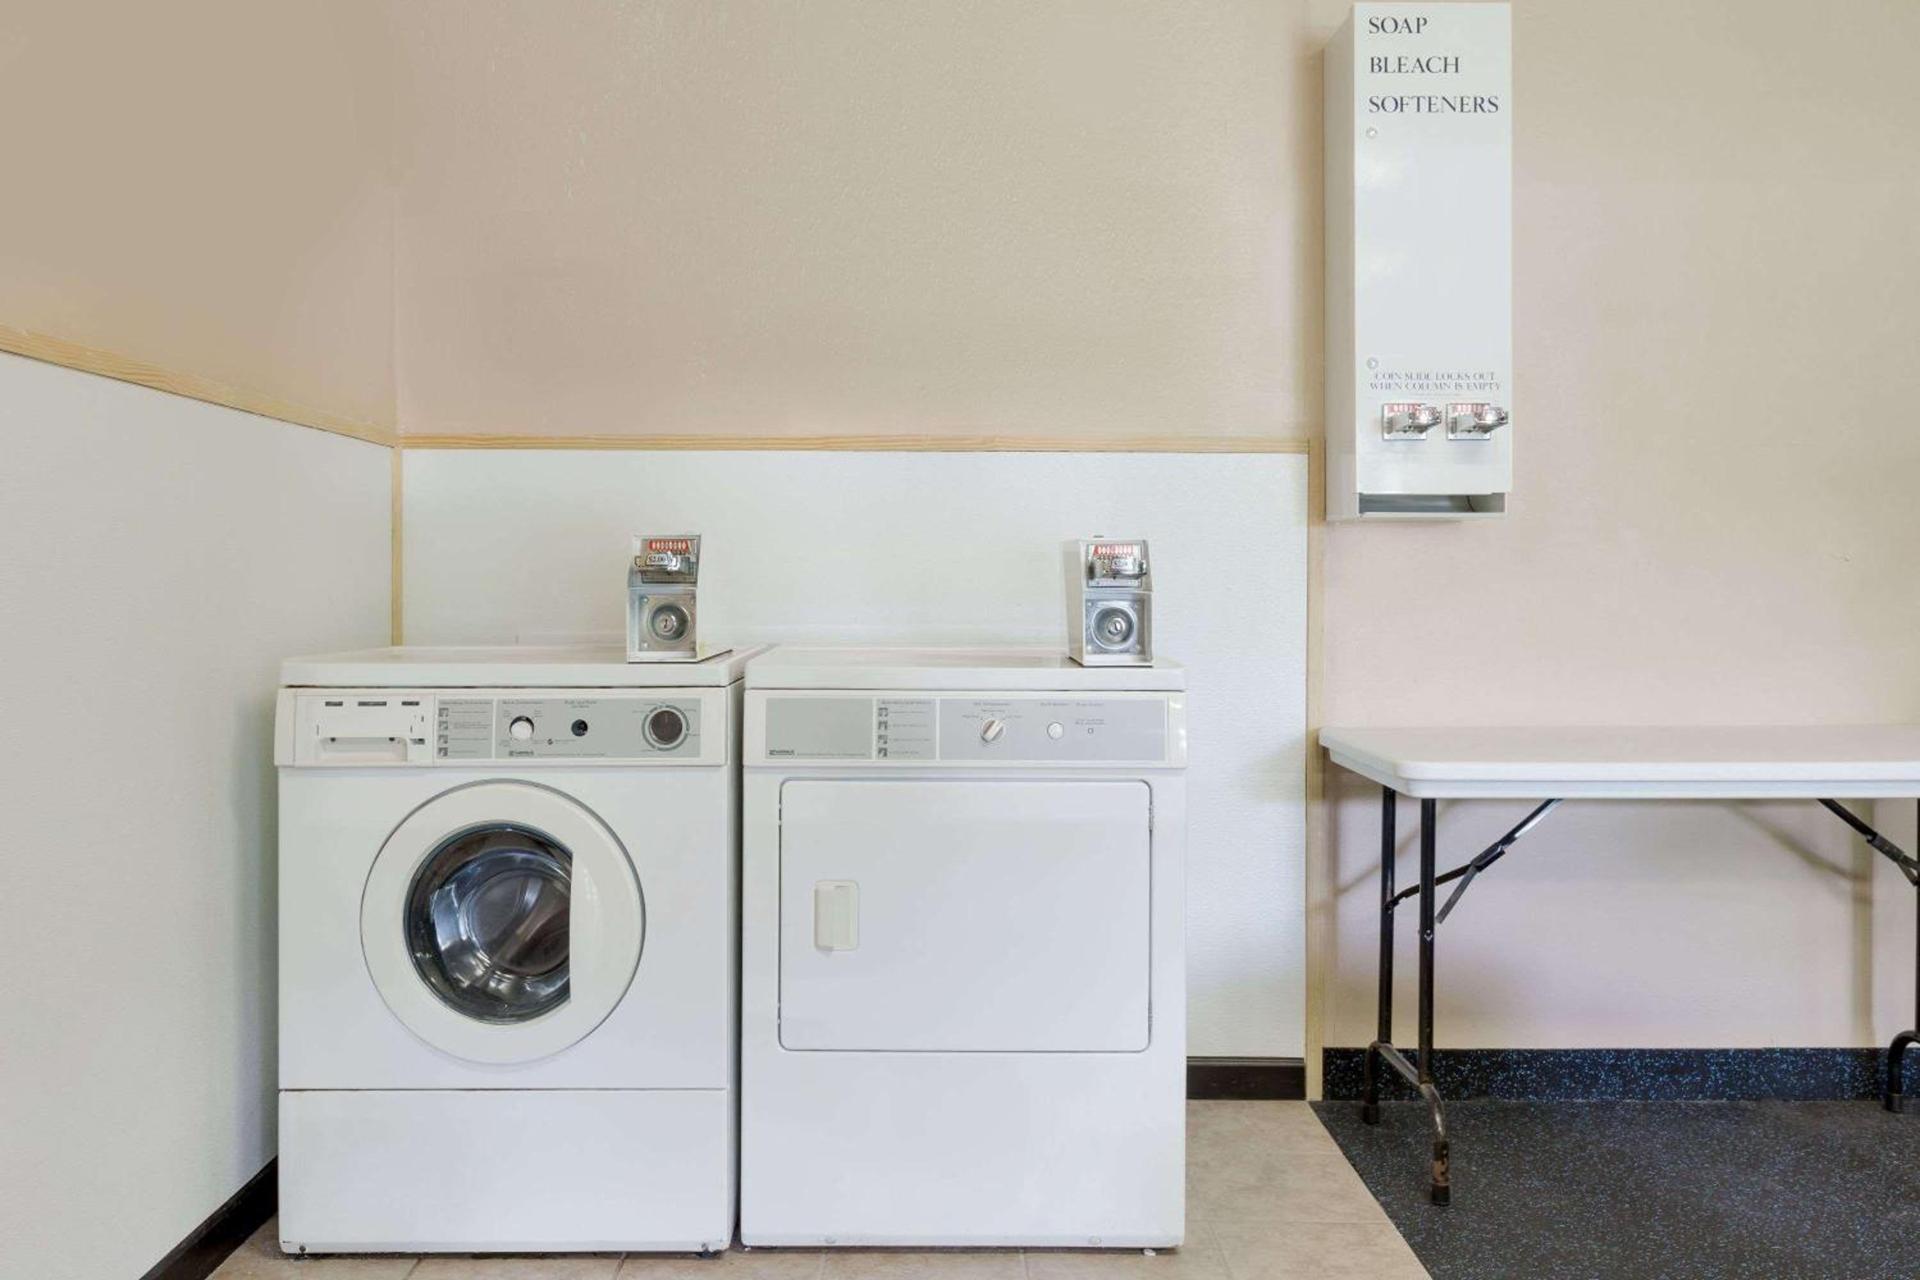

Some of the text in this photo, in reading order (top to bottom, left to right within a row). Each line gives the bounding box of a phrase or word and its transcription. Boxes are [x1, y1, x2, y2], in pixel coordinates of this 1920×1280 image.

[1368, 16, 1428, 34] SOAP
[1369, 56, 1460, 74] BLEACH
[1368, 96, 1499, 114] SOFTENERS
[1435, 372, 1470, 381] LOCKS
[1473, 372, 1496, 381] OUT
[1369, 382, 1402, 391] WHEN
[1454, 382, 1463, 391] IS
[1466, 382, 1500, 391] EMPTY
